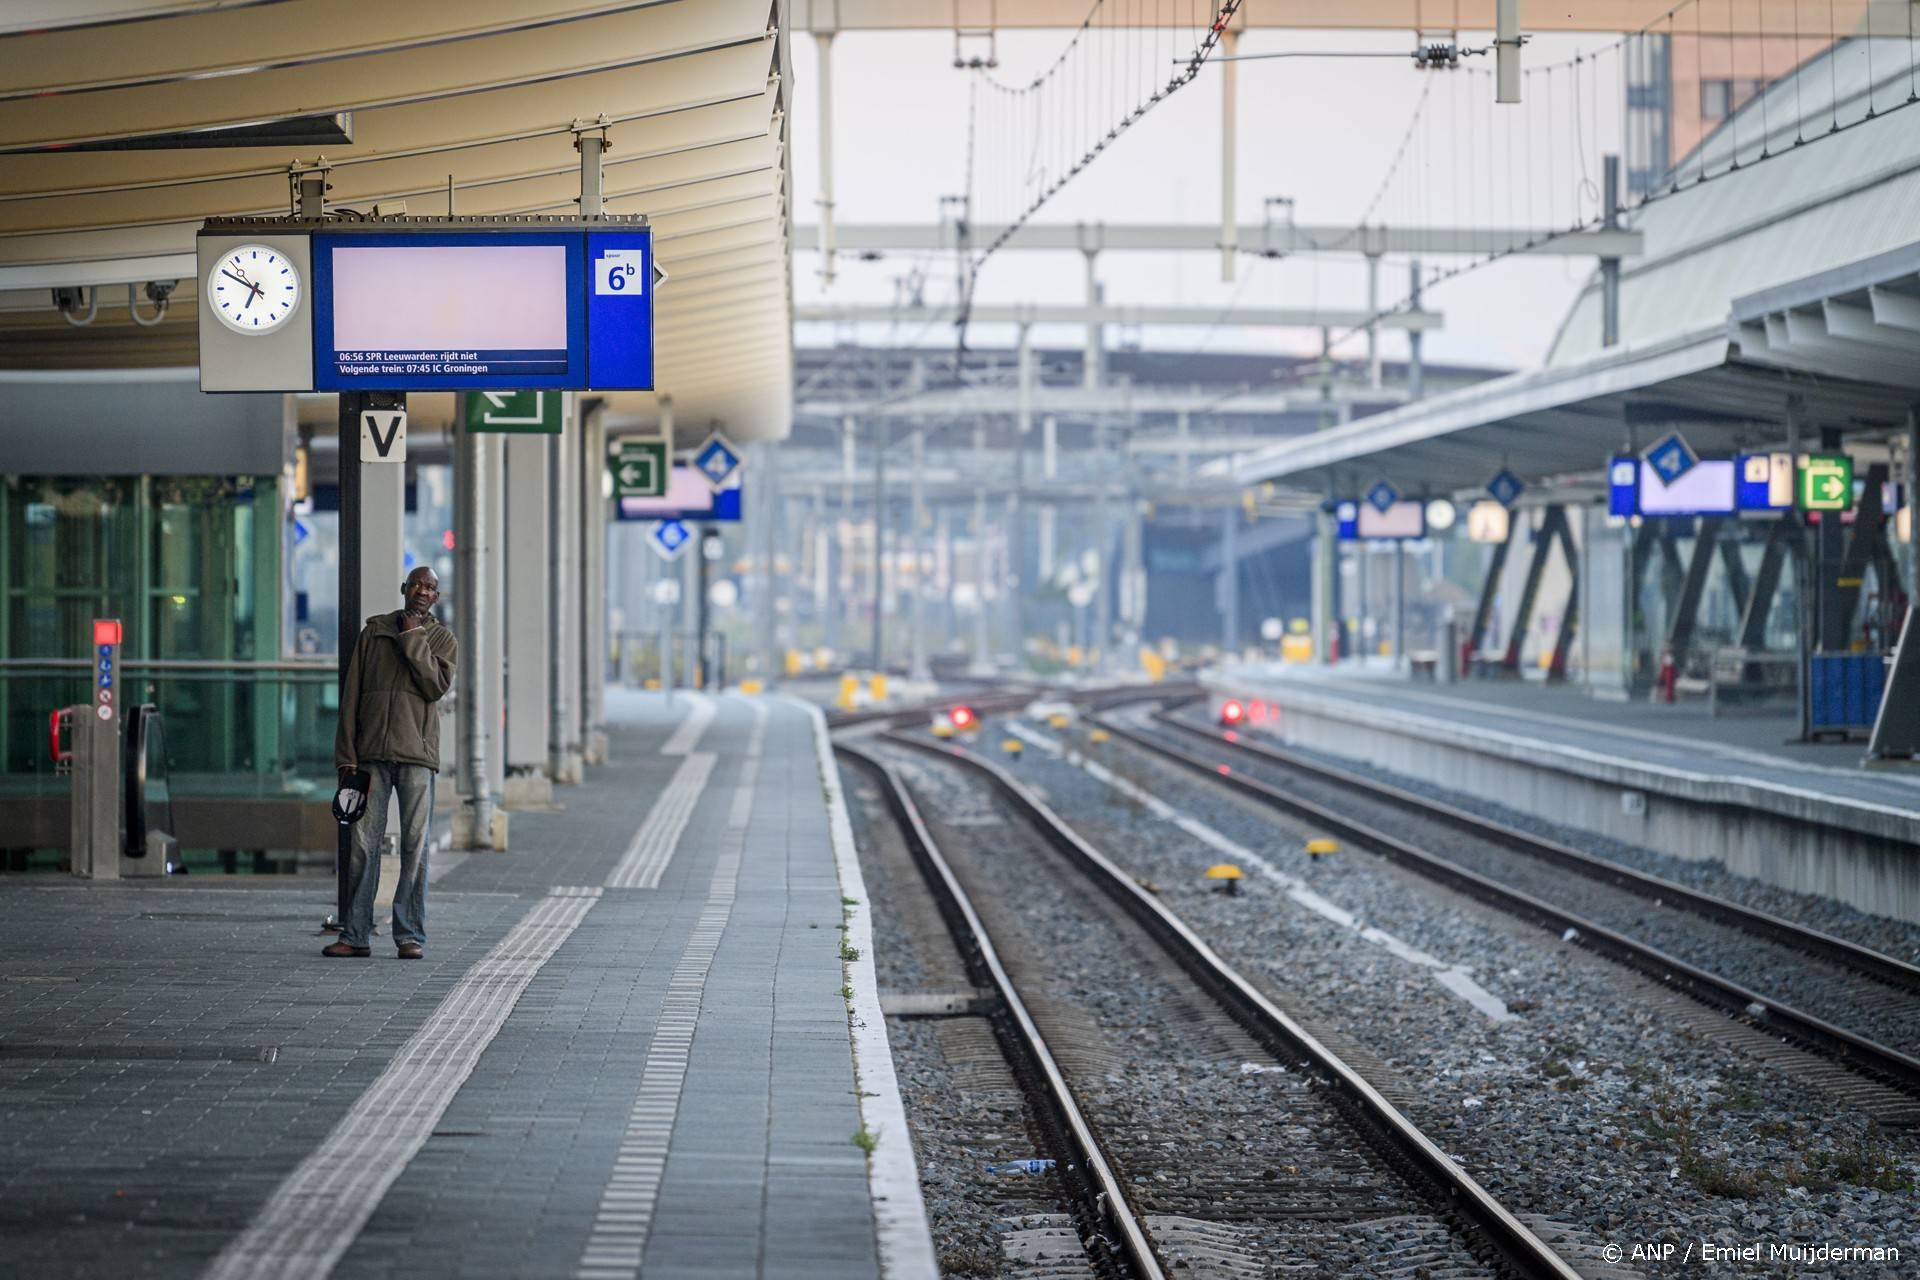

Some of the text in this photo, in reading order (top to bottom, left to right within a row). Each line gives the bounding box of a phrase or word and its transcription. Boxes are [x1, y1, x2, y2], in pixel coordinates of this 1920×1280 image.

[339, 352, 478, 362] 06:56 SPR Leeuwarden: rijdt niet
[339, 364, 488, 375] Volgende trein: 07:45 IC Groningen
[365, 416, 402, 457] V
